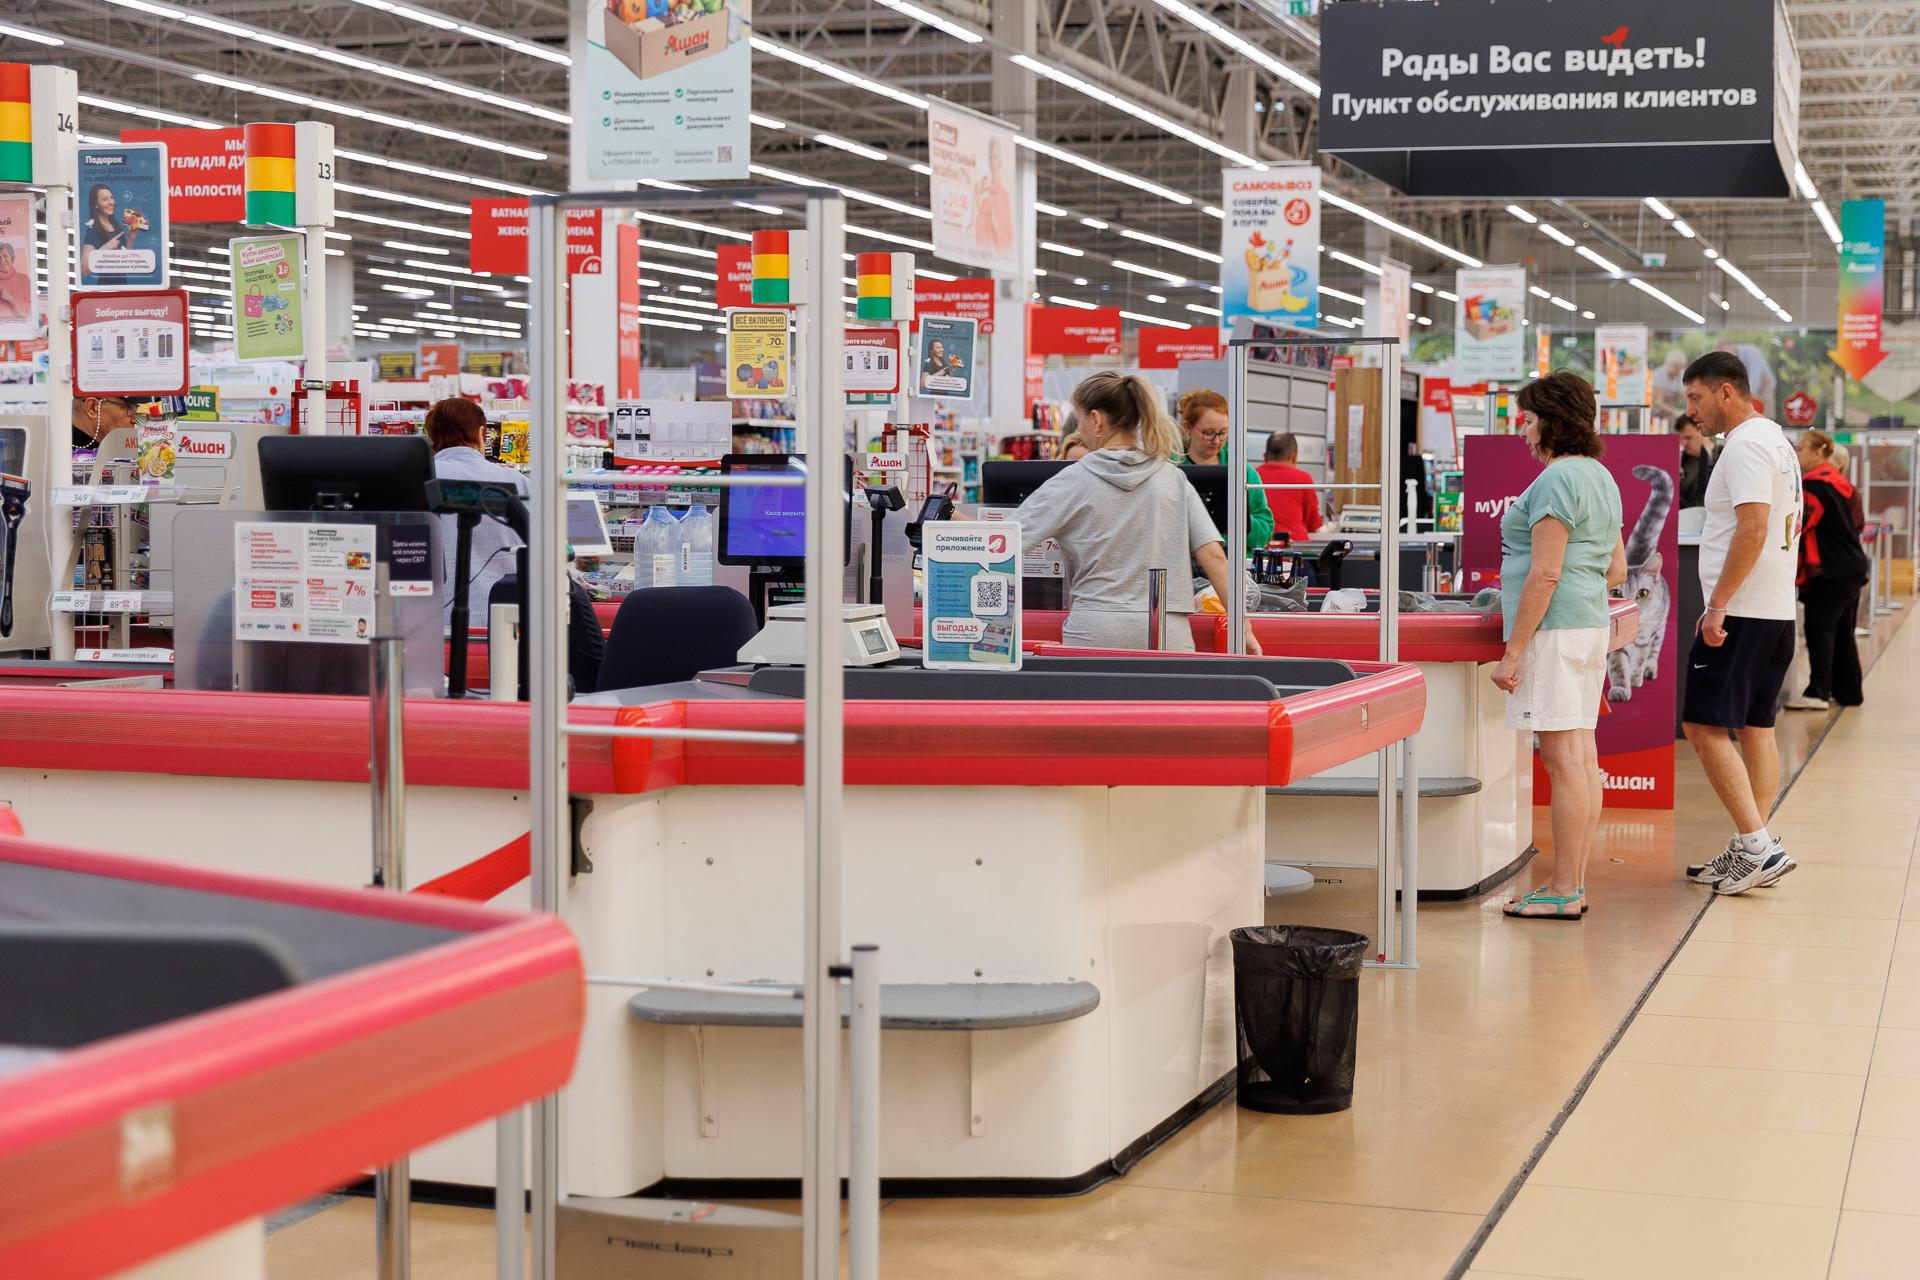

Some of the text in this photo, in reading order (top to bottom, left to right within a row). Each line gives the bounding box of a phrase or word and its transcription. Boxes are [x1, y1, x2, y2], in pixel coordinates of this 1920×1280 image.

[664, 31, 709, 56] Ашан
[1382, 37, 1706, 81] Рады Вас видеть!
[1332, 88, 1758, 121] Пункт обслуживания клиентов
[57, 113, 74, 134] 14
[225, 140, 246, 151] МЫ
[85, 156, 123, 165] Подарок
[171, 155, 246, 170] ГЕЛИ ДЛЯ ДУ
[318, 162, 332, 181] 13
[184, 184, 242, 197] ПОЛОСТИ
[497, 226, 529, 236] ЖЕНС
[95, 305, 169, 319] Заберите выгоду!
[735, 316, 784, 325] ВСЁ ВКЛЮЧЕНО
[186, 394, 210, 408] OLIVE
[178, 436, 225, 454] Ашан
[870, 456, 902, 467] Ашан
[1475, 496, 1518, 518] мур
[935, 534, 983, 543] Скачивайте
[1046, 541, 1060, 550] 7%
[345, 580, 366, 596] 7%
[937, 624, 979, 633] ВЫГОДА25
[608, 1236, 734, 1258] nedap
